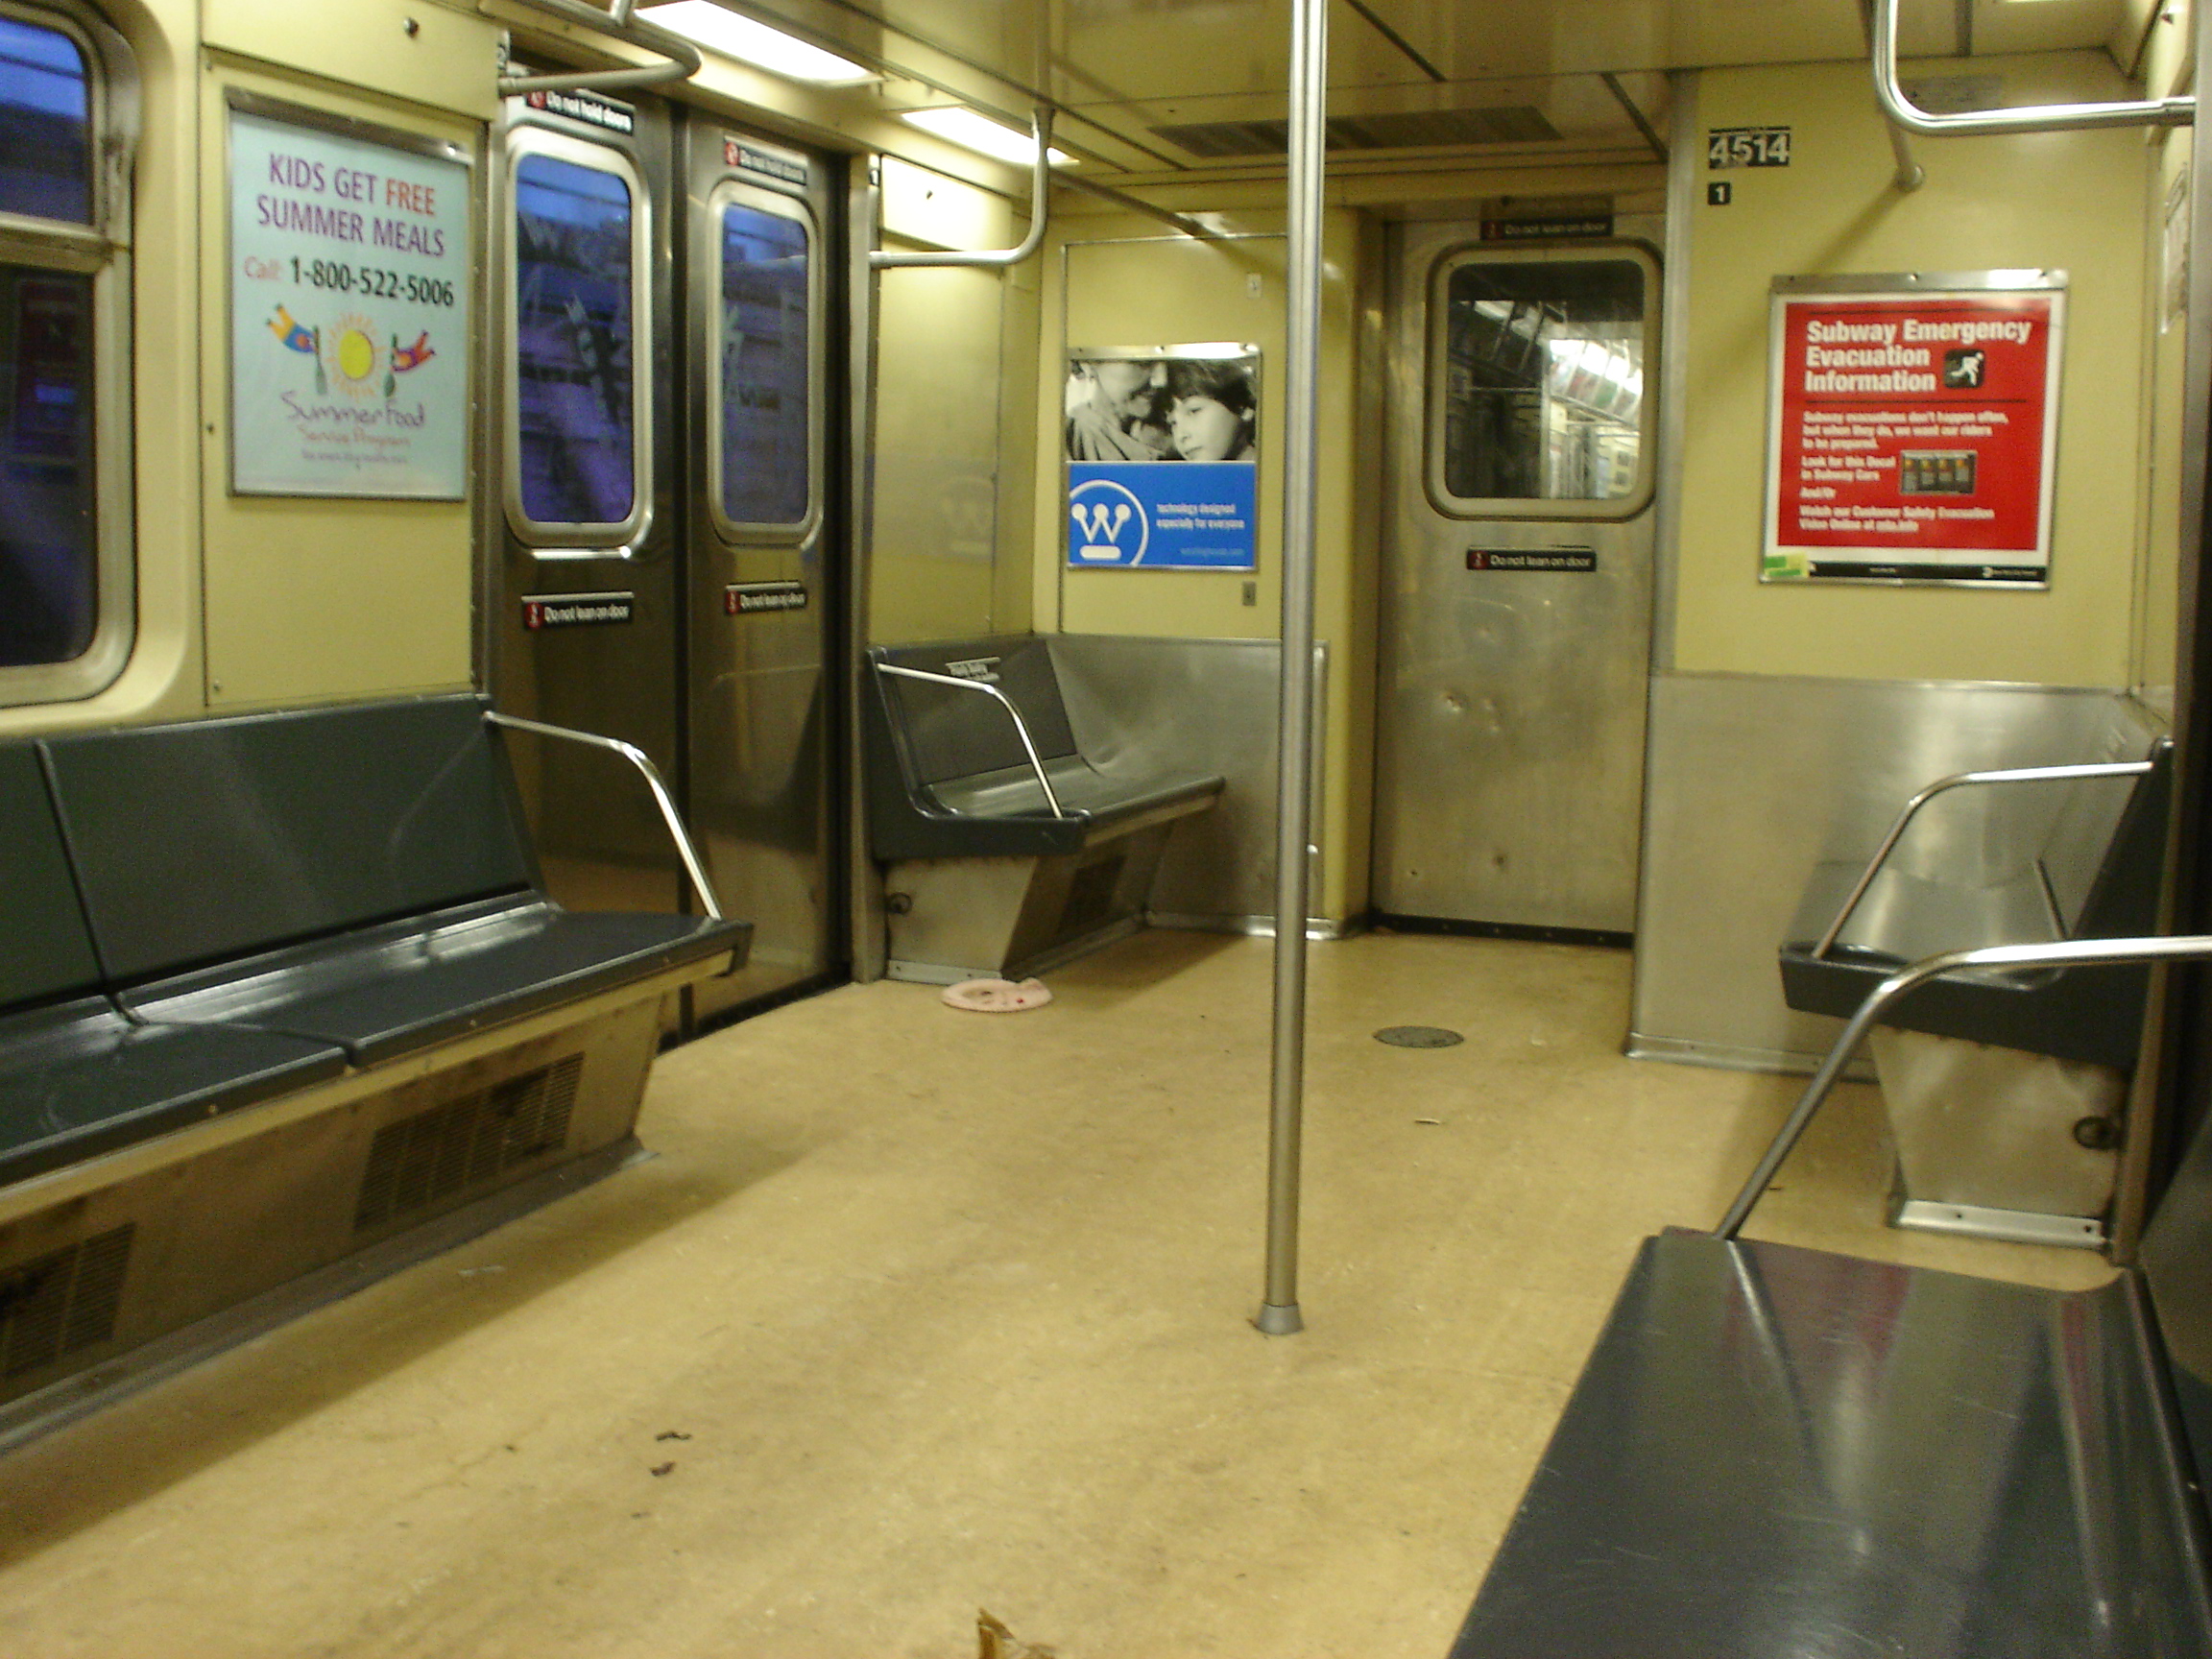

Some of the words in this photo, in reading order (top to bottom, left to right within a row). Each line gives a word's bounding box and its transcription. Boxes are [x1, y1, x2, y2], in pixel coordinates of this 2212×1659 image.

[1710, 133, 1788, 163] 4514
[270, 152, 325, 193] KIDS
[333, 167, 377, 204] GET
[385, 179, 435, 215] FREE
[1715, 184, 1725, 203] 1
[257, 194, 364, 244] SUMMER
[373, 217, 445, 257] MEALS
[290, 255, 454, 307] 1-800-522-5006
[1807, 320, 1897, 345] Subway
[1903, 318, 2032, 345] Emergency
[1806, 345, 1931, 368] Evacuation
[1805, 370, 1936, 392] Information
[280, 390, 384, 424] Summer
[1490, 555, 1506, 565] Do
[1507, 556, 1525, 565] not
[1526, 555, 1551, 566] lean
[1551, 557, 1566, 566] on
[1566, 556, 1591, 566] door
[544, 606, 558, 623] Do
[558, 605, 575, 622] not
[576, 605, 594, 621] lean
[595, 606, 608, 620] on
[608, 603, 629, 620] door
